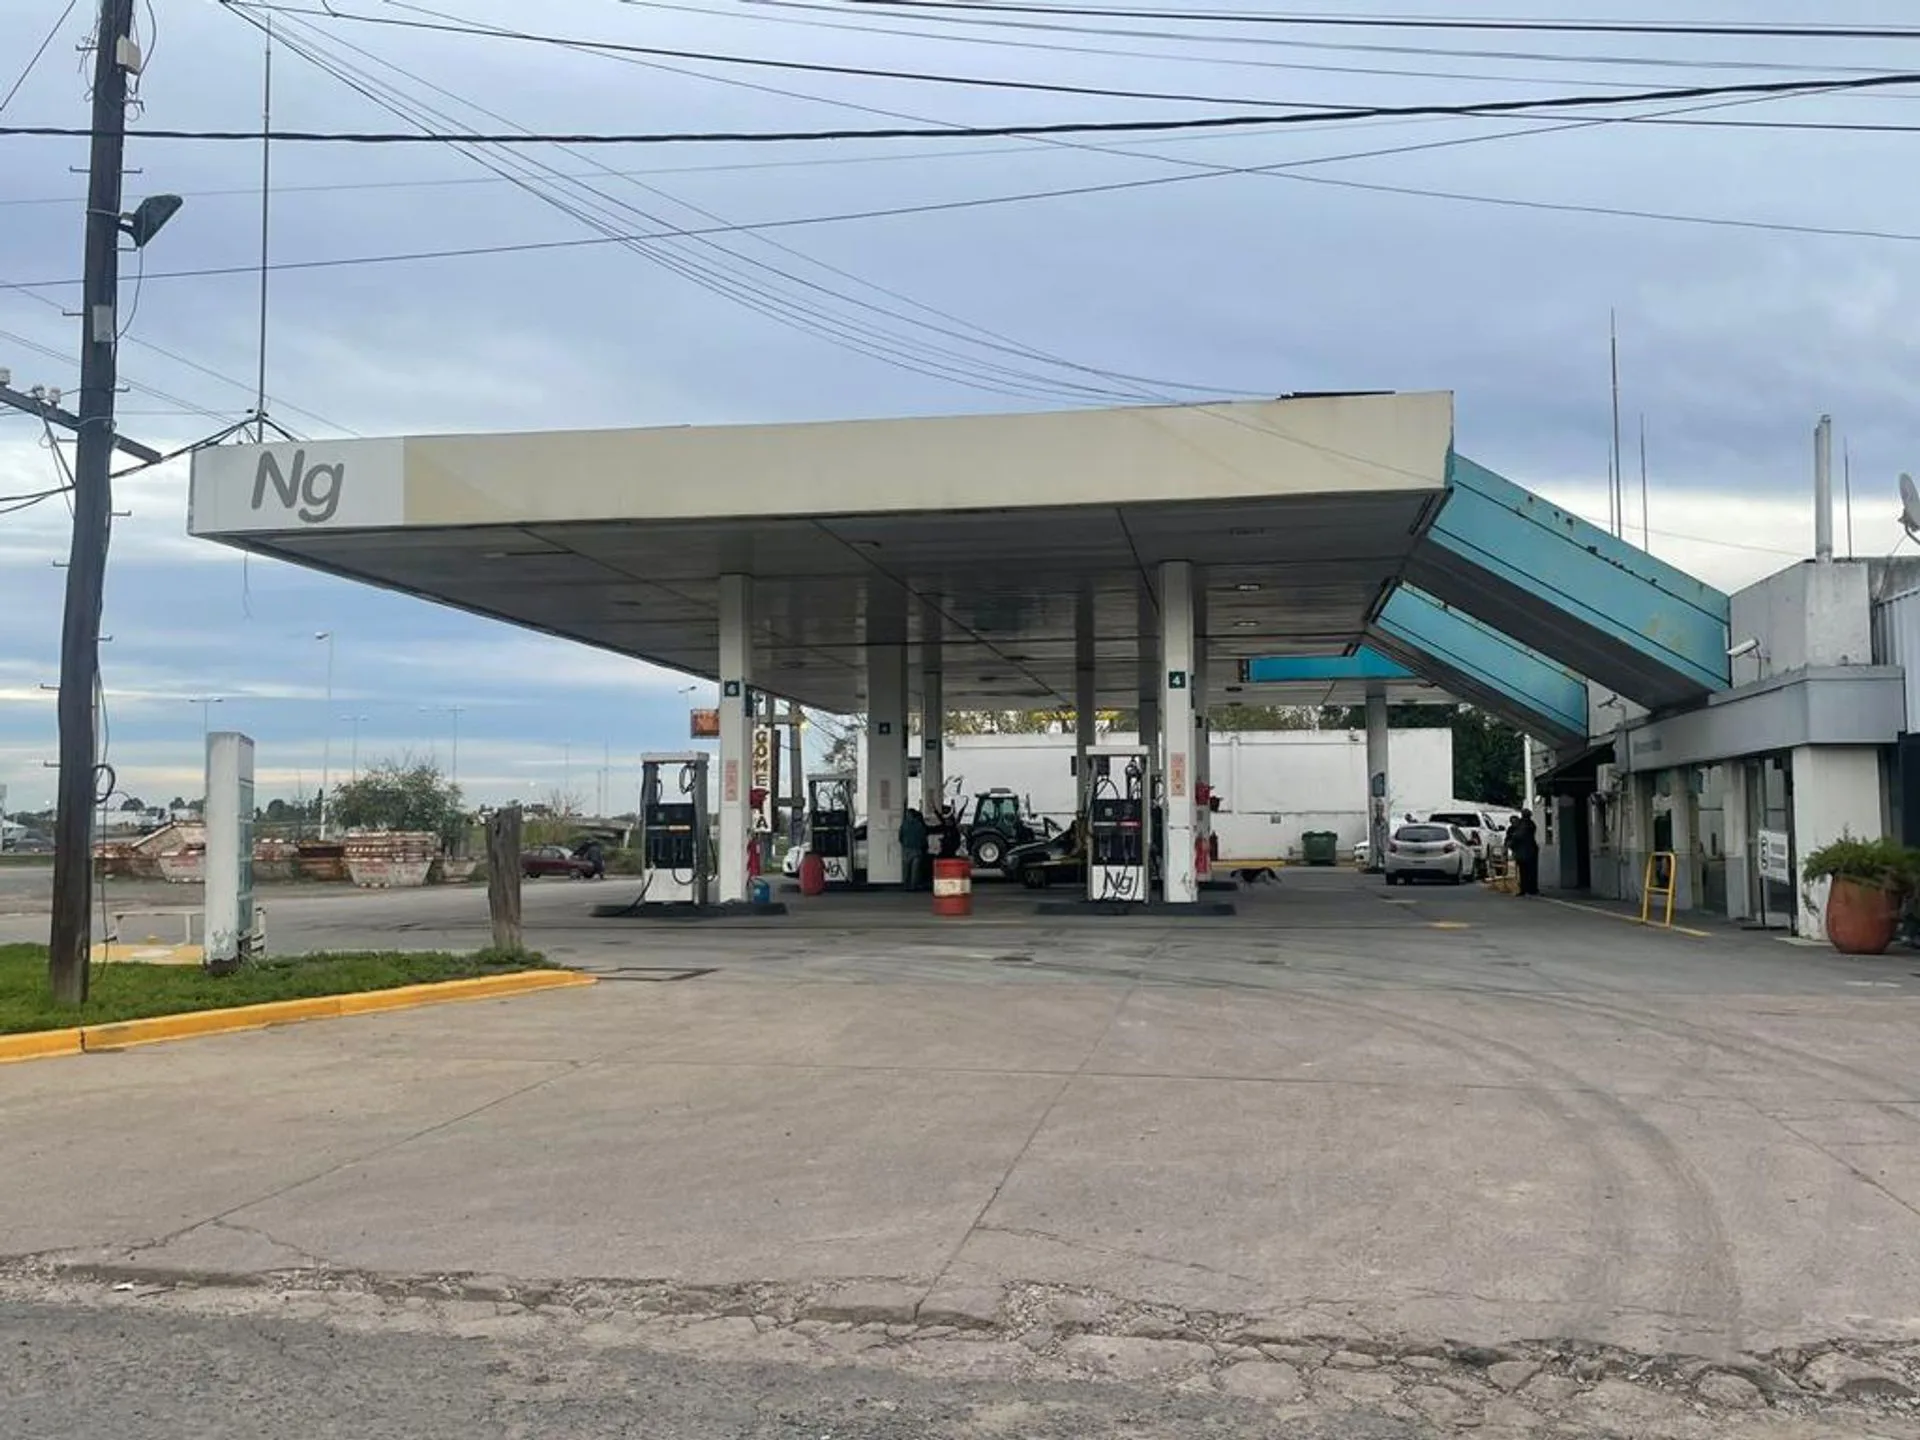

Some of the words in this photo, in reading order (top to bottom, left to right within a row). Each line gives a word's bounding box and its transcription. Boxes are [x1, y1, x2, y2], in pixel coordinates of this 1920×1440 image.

[252, 449, 344, 523] Ng
[1172, 674, 1181, 686] 4
[753, 730, 769, 829] GOMEIA
[1104, 870, 1133, 895] Ng
